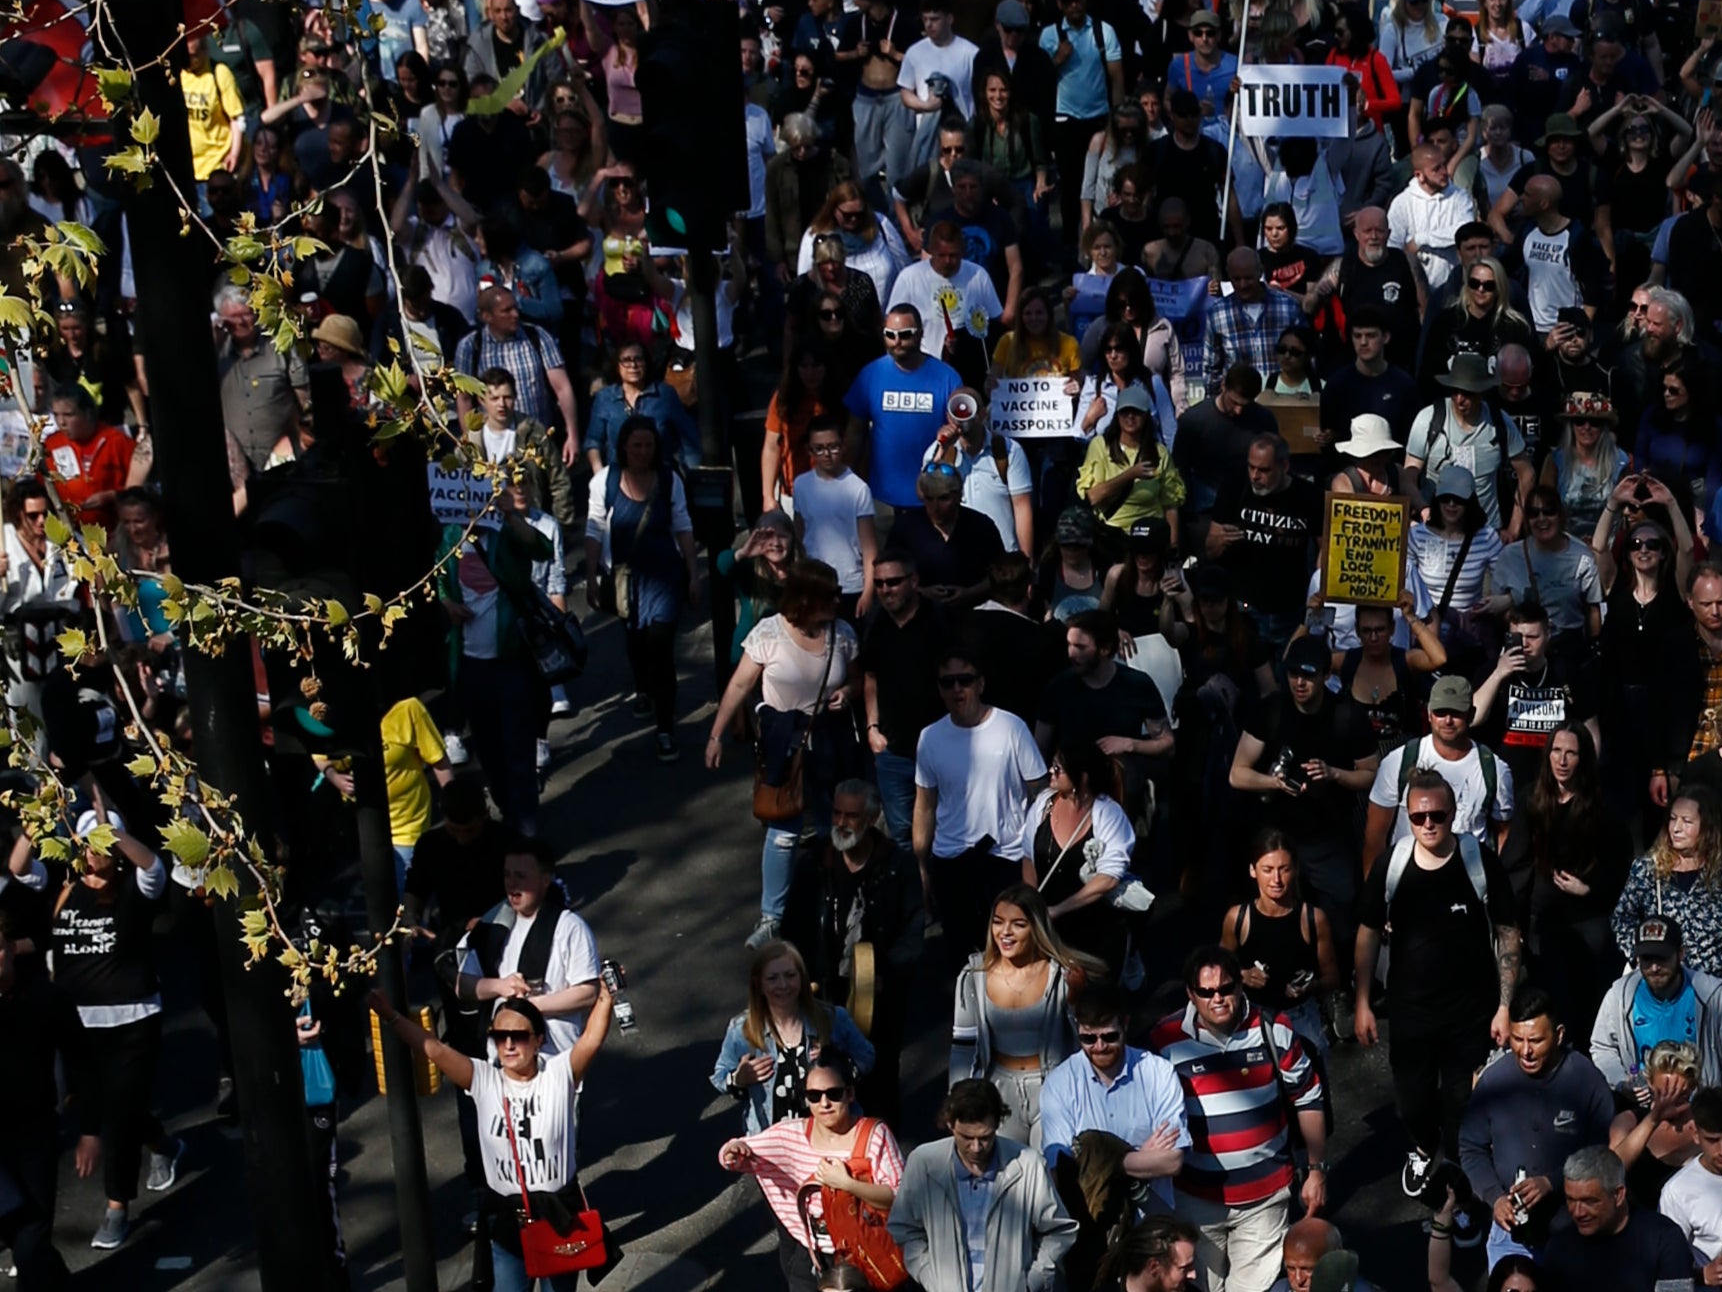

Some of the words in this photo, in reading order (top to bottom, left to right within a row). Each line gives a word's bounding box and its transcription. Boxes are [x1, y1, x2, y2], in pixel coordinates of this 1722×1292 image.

[1244, 83, 1340, 118] TRUTH
[1532, 241, 1550, 252] WAKE
[1552, 244, 1563, 253] UP
[1529, 251, 1561, 263] SHEEPLE
[1009, 381, 1028, 393] NO
[1033, 381, 1050, 392] TO
[1001, 400, 1059, 413] VACCINE
[993, 418, 1071, 431] PASSPORTS
[1241, 507, 1308, 530] CITIZEN
[1333, 503, 1402, 523] FREEDOM
[1341, 520, 1386, 536] FROM
[1245, 529, 1272, 546] TAY
[1333, 533, 1400, 553] TYRANNY!
[1345, 549, 1374, 562] END
[1340, 561, 1374, 574] LOCK
[1340, 573, 1386, 588] DOWNS
[1349, 583, 1390, 598] NOW!
[1513, 701, 1561, 718] ADVISORY
[64, 943, 114, 954] ALONE
